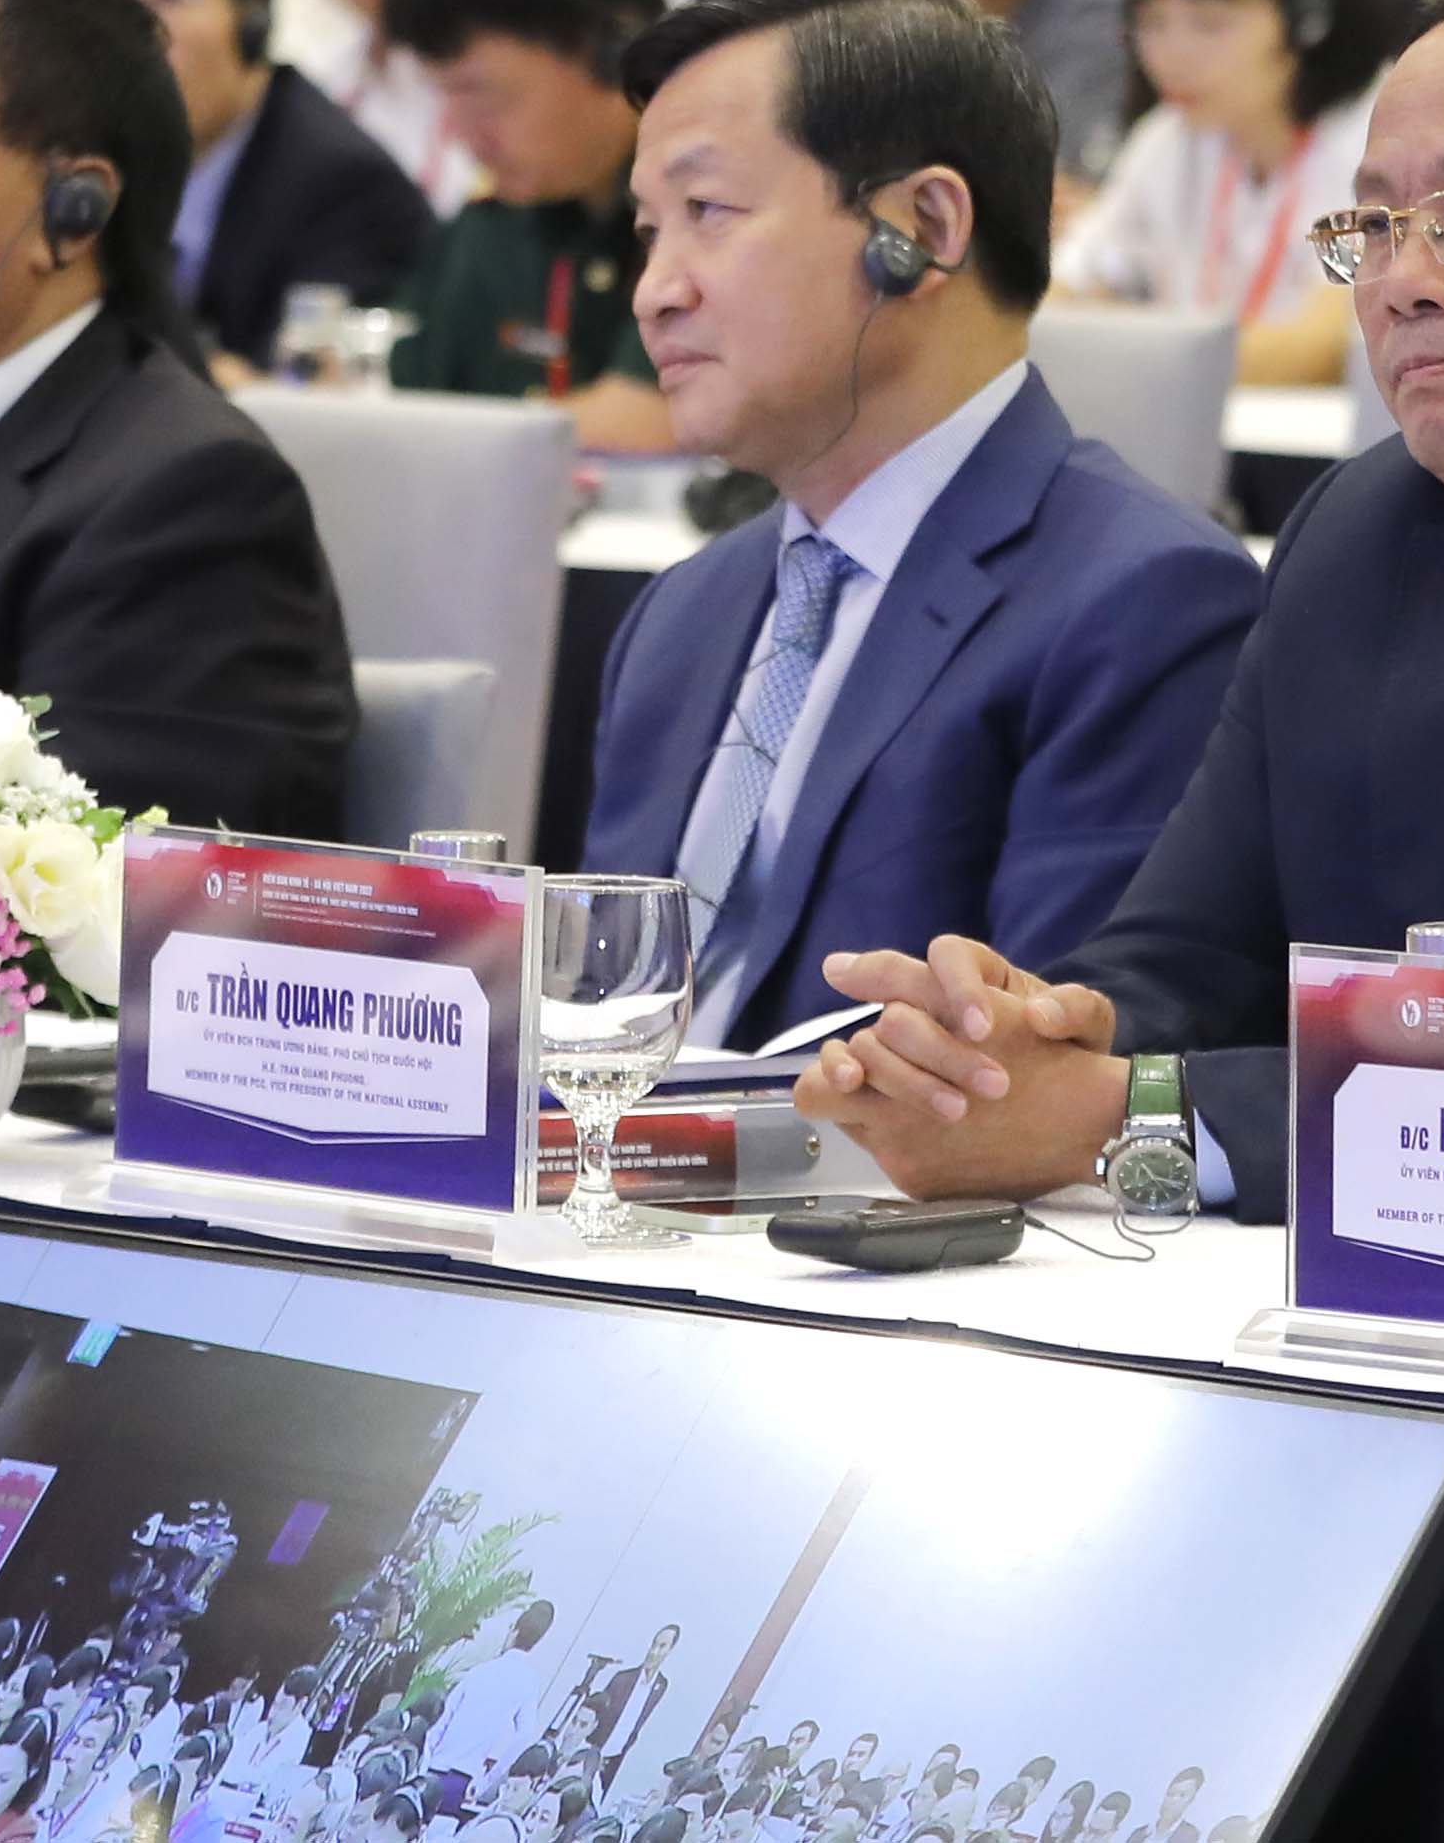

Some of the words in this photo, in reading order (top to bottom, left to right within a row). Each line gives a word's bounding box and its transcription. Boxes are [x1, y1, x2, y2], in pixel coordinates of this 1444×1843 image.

[207, 962, 267, 1021] TRẦN
[276, 981, 354, 1032] QUANG
[363, 991, 461, 1047] PHƯƠNG
[185, 1069, 218, 1084] MEMBER
[221, 1074, 230, 1085] OF
[233, 1075, 247, 1087] THE
[271, 1080, 286, 1092] VICE
[289, 1083, 331, 1098] PRESIDENT
[334, 1088, 344, 1099] OF
[347, 1090, 362, 1102] THE
[365, 1092, 403, 1108] NATIONAL
[407, 1098, 448, 1113] ASSEMBLY
[1401, 1126, 1428, 1150] Đ/C
[1417, 1166, 1440, 1180] VIÊN
[1377, 1208, 1419, 1222] MEMBER
[1422, 1212, 1434, 1224] OF
